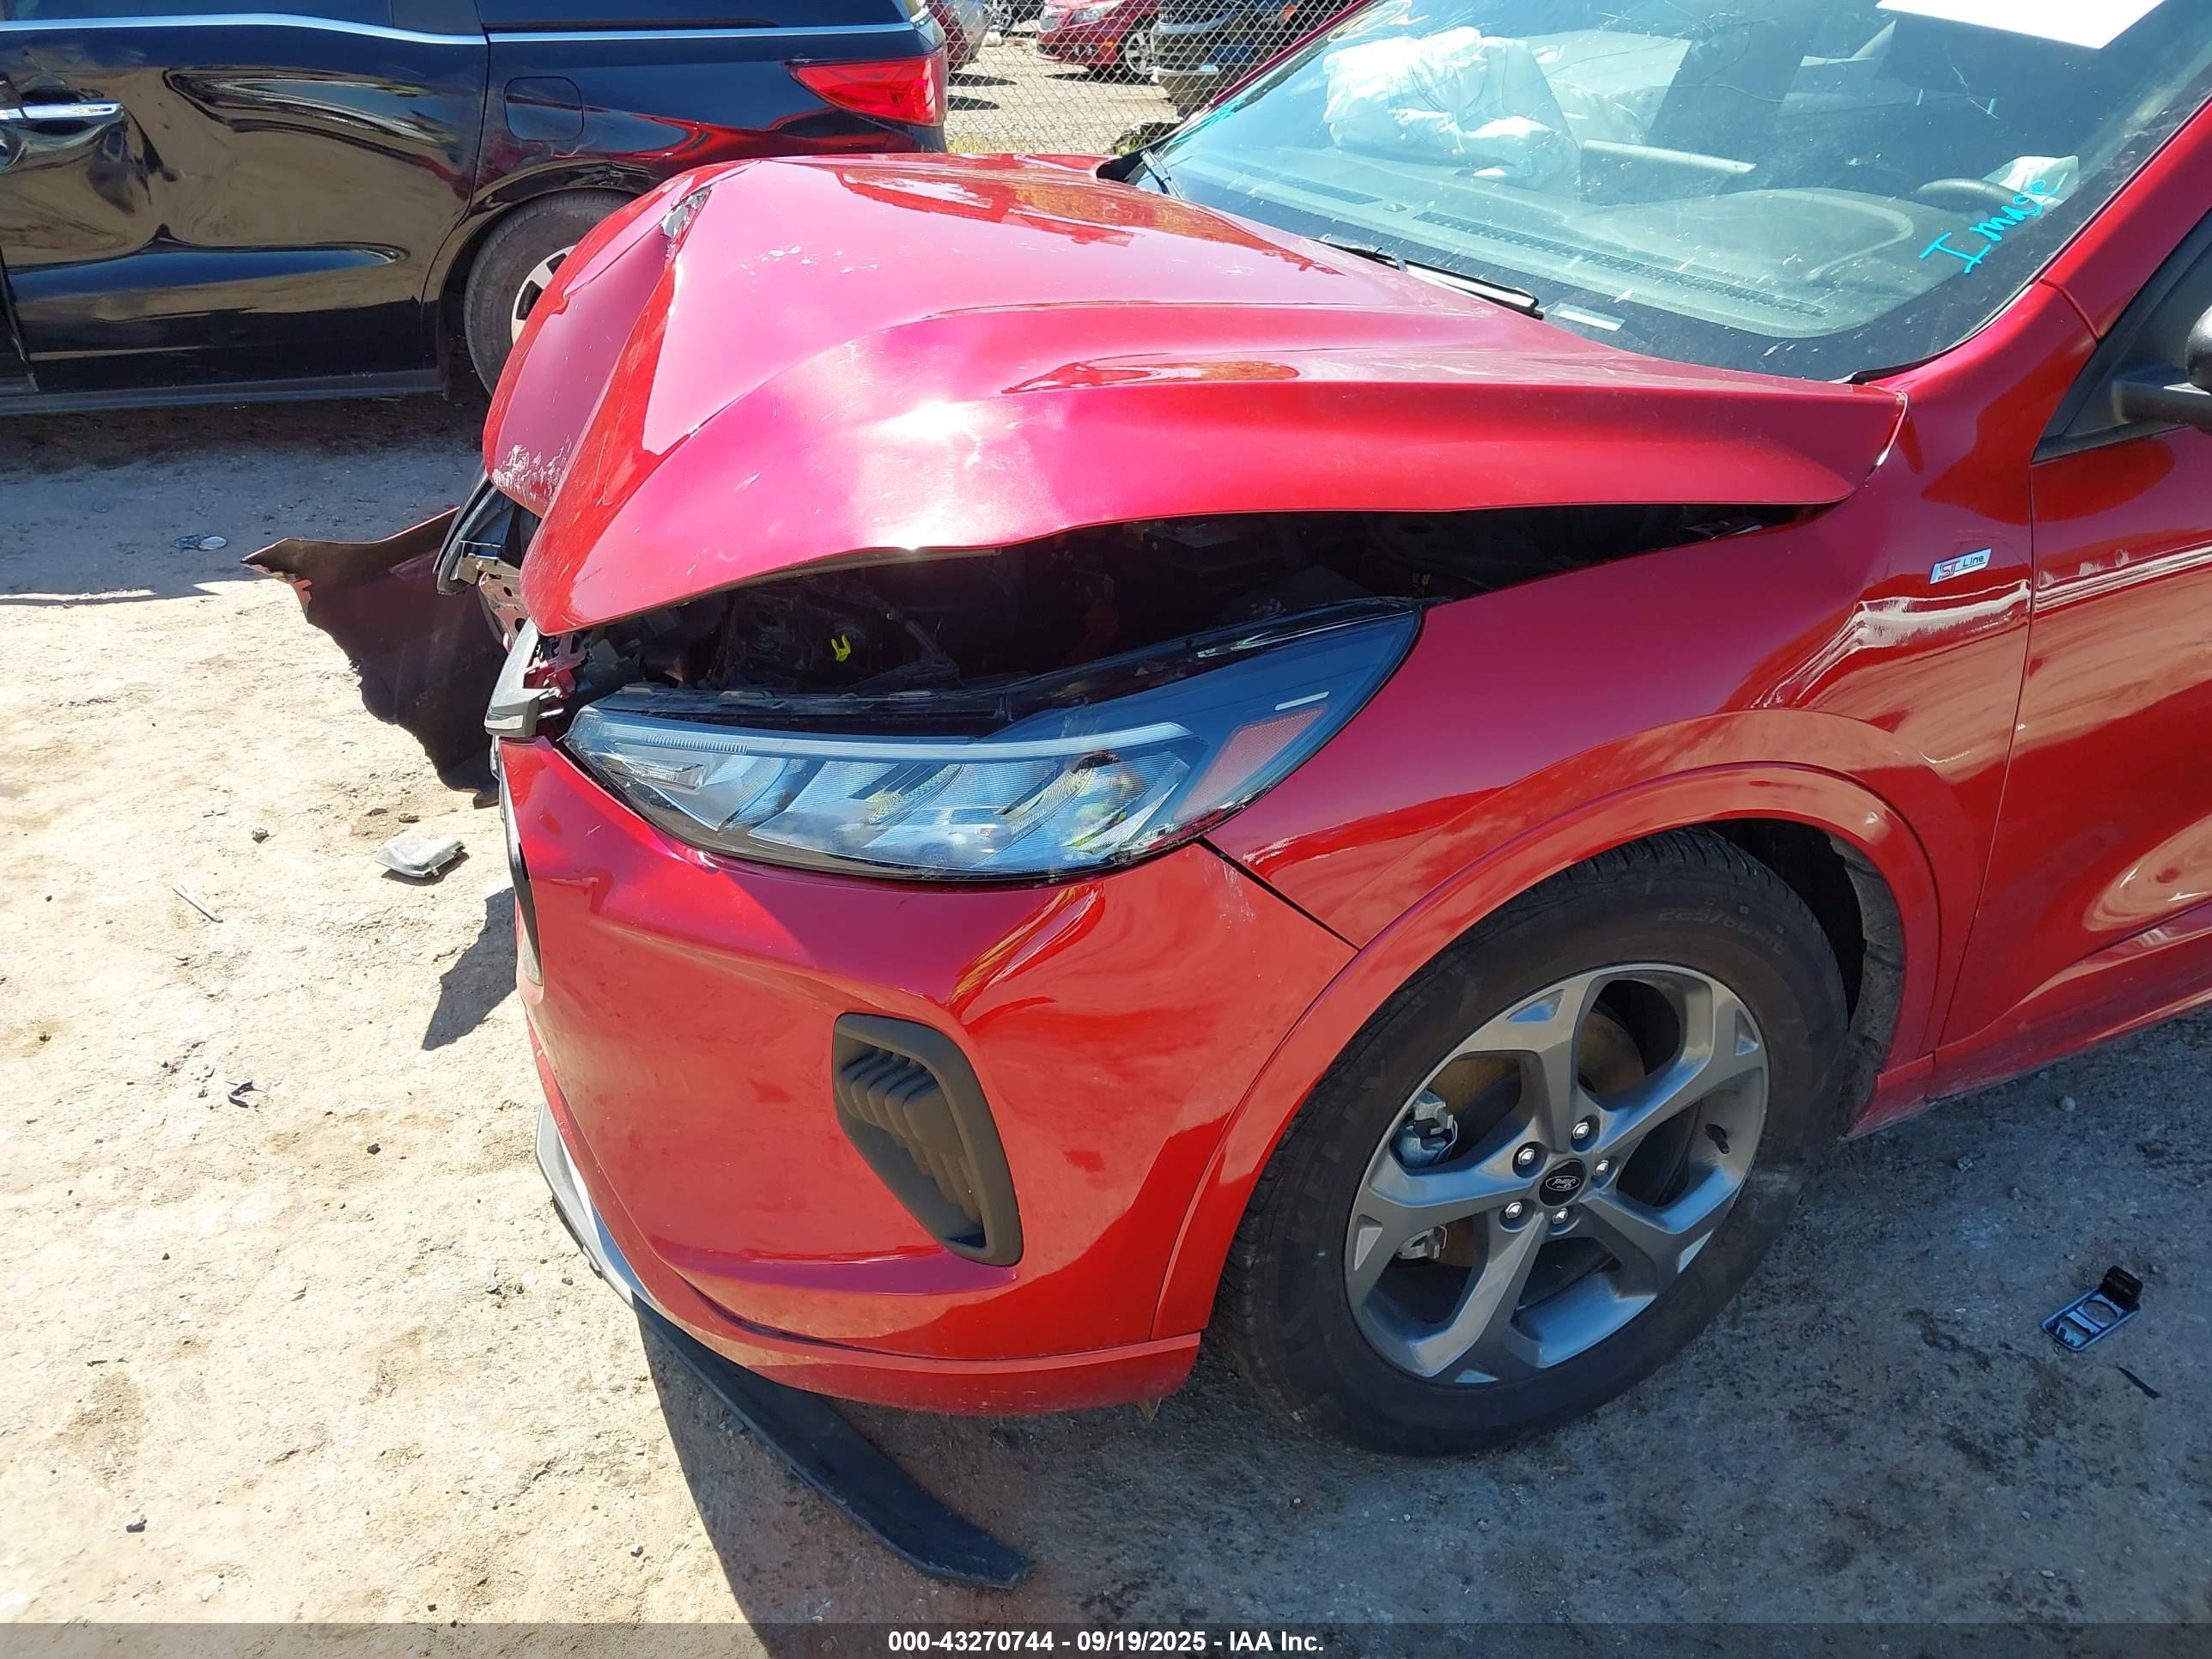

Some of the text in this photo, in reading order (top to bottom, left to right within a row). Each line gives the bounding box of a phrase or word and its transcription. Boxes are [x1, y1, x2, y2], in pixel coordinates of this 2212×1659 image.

[1937, 555, 1984, 580] ST Line
[1550, 1177, 1577, 1190] Ford
